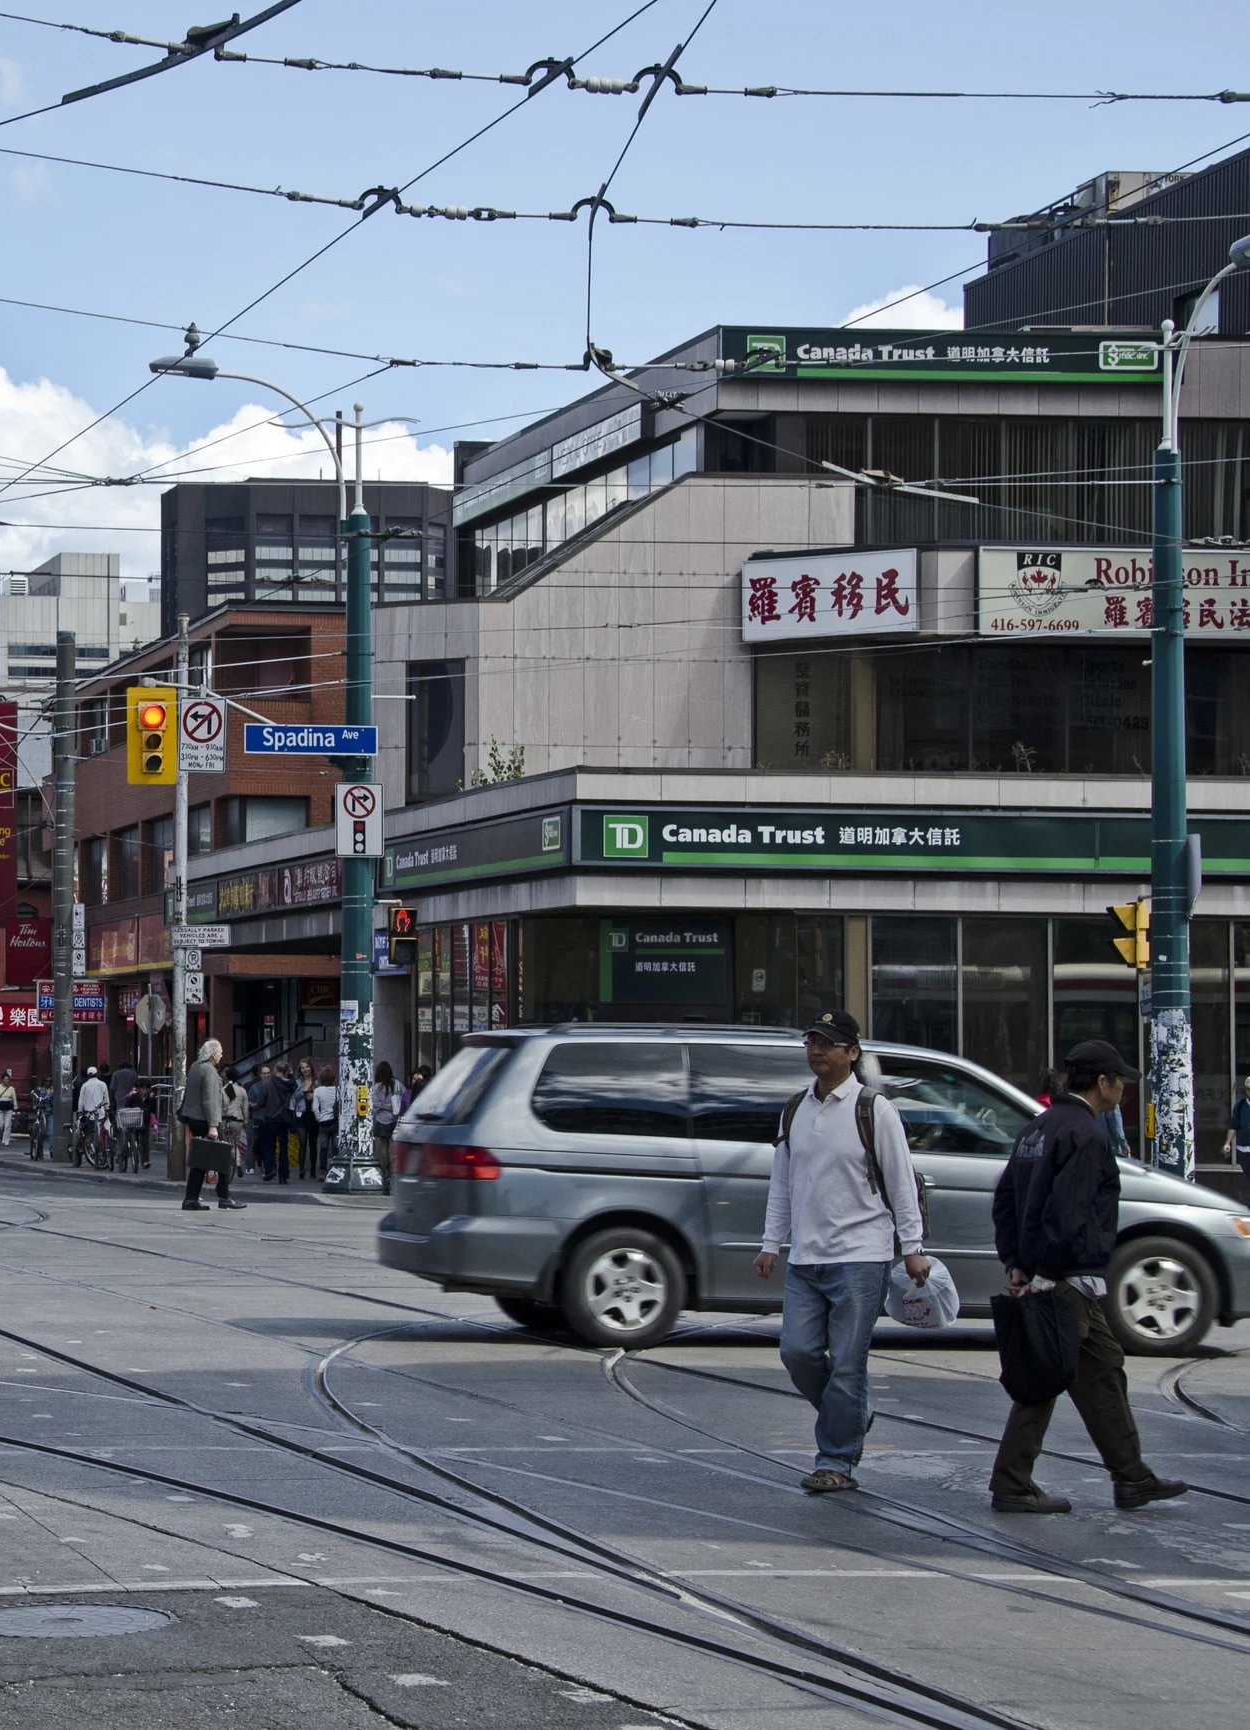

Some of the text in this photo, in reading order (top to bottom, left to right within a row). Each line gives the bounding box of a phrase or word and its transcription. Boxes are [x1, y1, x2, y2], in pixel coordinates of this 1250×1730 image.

[797, 343, 872, 361] Canada
[878, 344, 935, 361] Trust
[1023, 553, 1056, 566] RIC
[1094, 557, 1219, 586] Robion
[748, 568, 909, 625] 羅賓移民
[1104, 596, 1250, 630] 羅賓民法
[990, 617, 1080, 632] 416-597-6699
[262, 727, 359, 750] Spadina Ave
[608, 823, 825, 850] TD Canada Trust
[838, 826, 960, 847] 道明加拿大信託
[396, 852, 414, 870] Canada
[414, 850, 429, 866] Trust
[19, 923, 38, 936] Tim
[9, 935, 47, 948] Hortons
[608, 932, 718, 948] TD Canada Trust
[634, 961, 696, 973] 道明加拿大信託
[310, 982, 333, 995] CIBC
[73, 998, 103, 1008] DENTISTS
